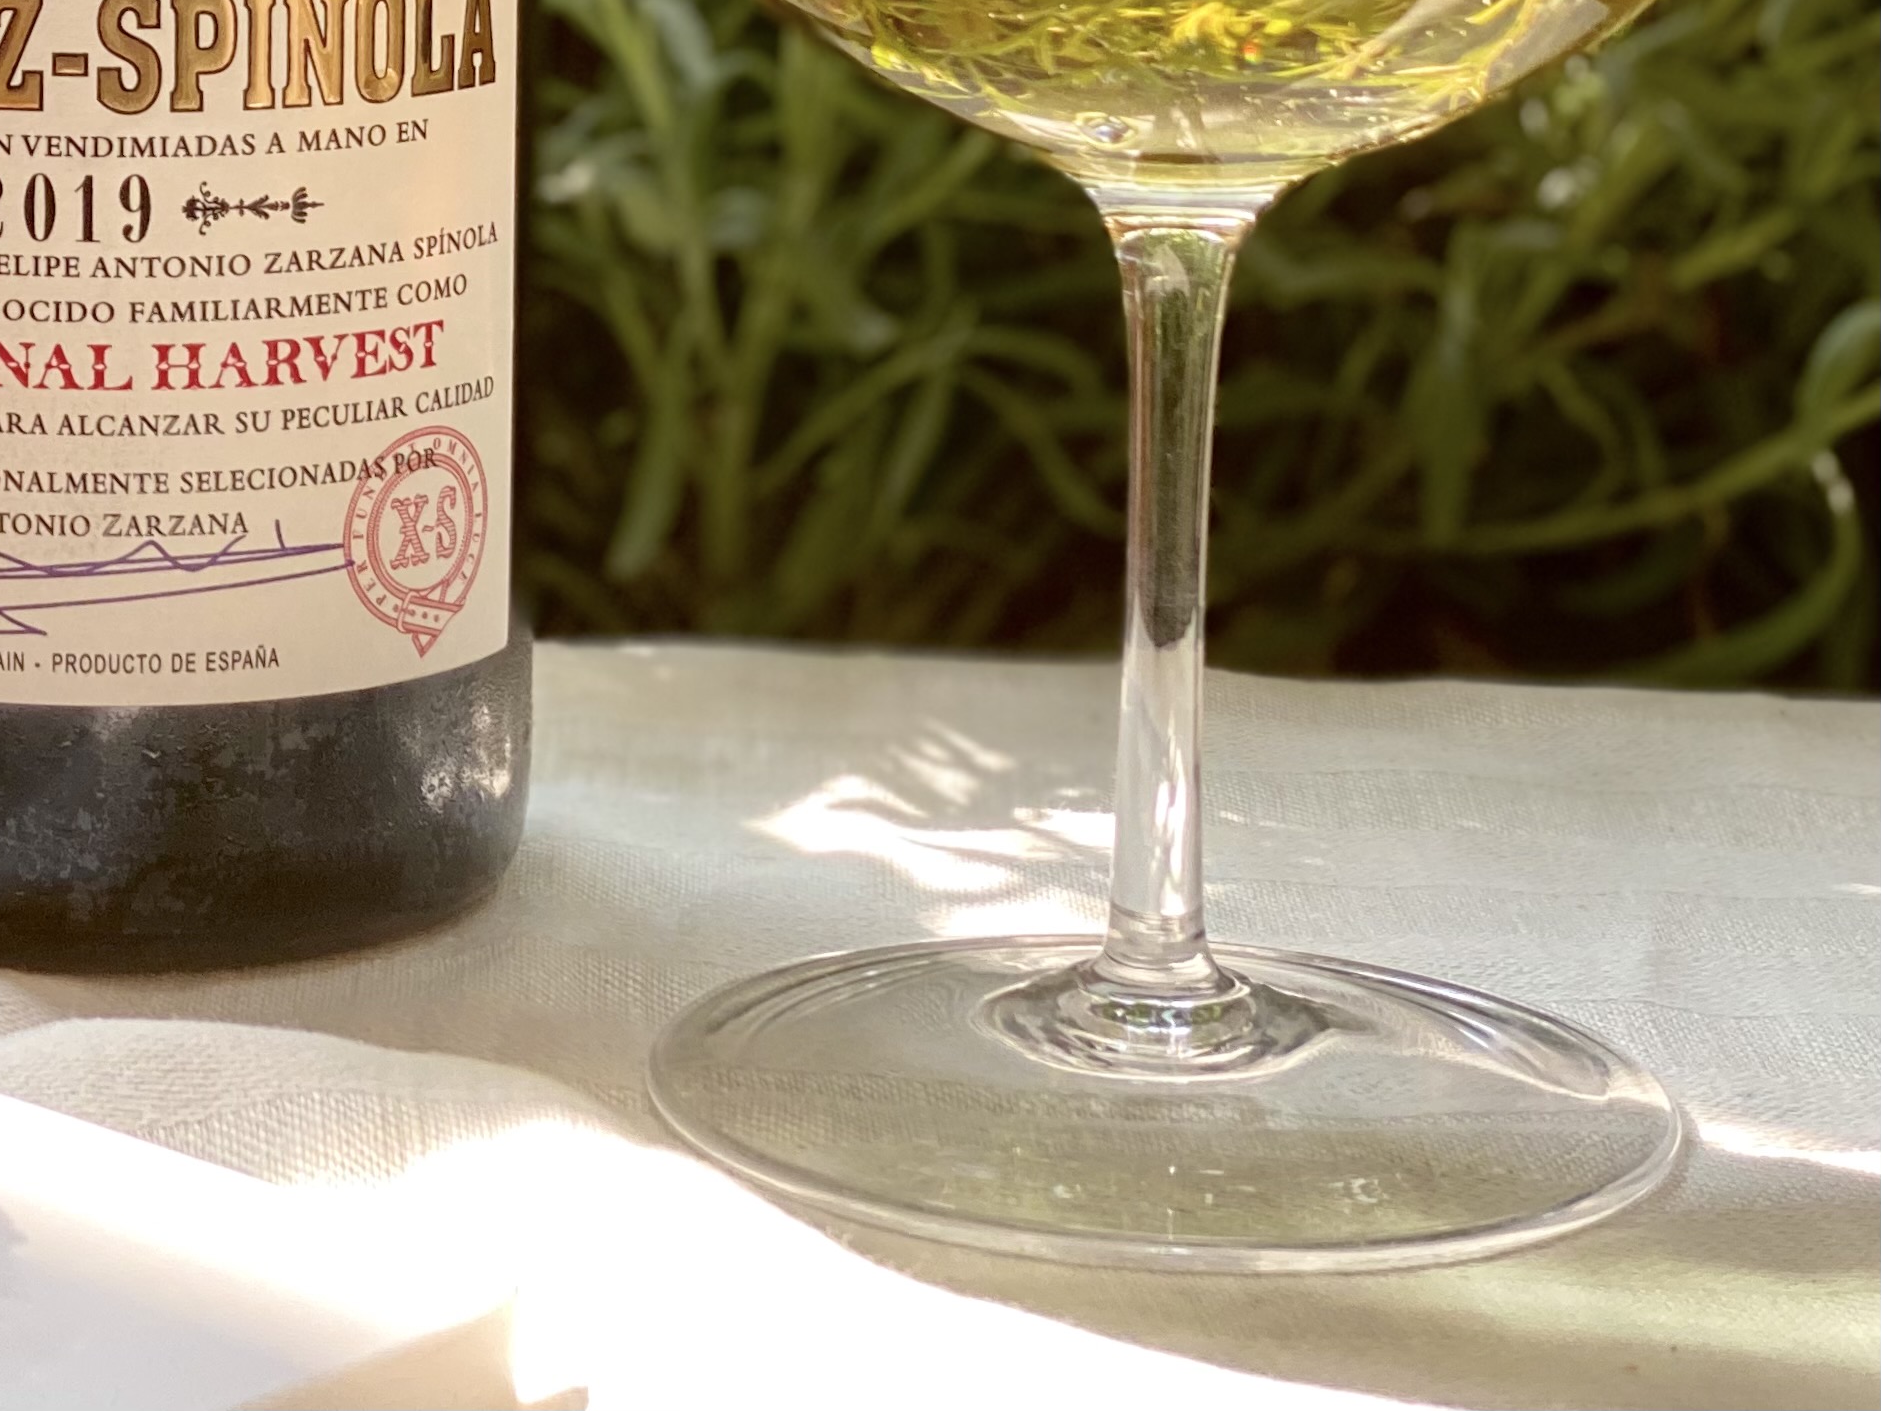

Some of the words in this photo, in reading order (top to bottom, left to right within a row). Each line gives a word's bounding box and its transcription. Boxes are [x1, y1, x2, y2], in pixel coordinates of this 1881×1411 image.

[21, 133, 256, 158] VENDIMIADAS
[265, 132, 286, 154] A
[296, 124, 387, 153] MANO
[396, 119, 429, 143] EN
[91, 253, 251, 279] ANTONIO
[264, 241, 405, 274] ZARZANA
[413, 221, 498, 261] SPÍNOLA
[128, 287, 388, 324] FAMILIARMENTE
[397, 273, 468, 306] COMO
[151, 319, 444, 391] HARVEST
[56, 413, 225, 437] ALCANZAR
[235, 411, 271, 434] SU
[281, 397, 408, 431] PECULIAR
[416, 375, 494, 414] CALIDAD
[179, 456, 387, 494] SELECIONADAS
[393, 447, 438, 474] POR
[102, 511, 249, 537] ZARZANA
[51, 652, 162, 674] PRODUCTO
[170, 652, 197, 673] DE
[205, 644, 280, 672] ESPAÑA
